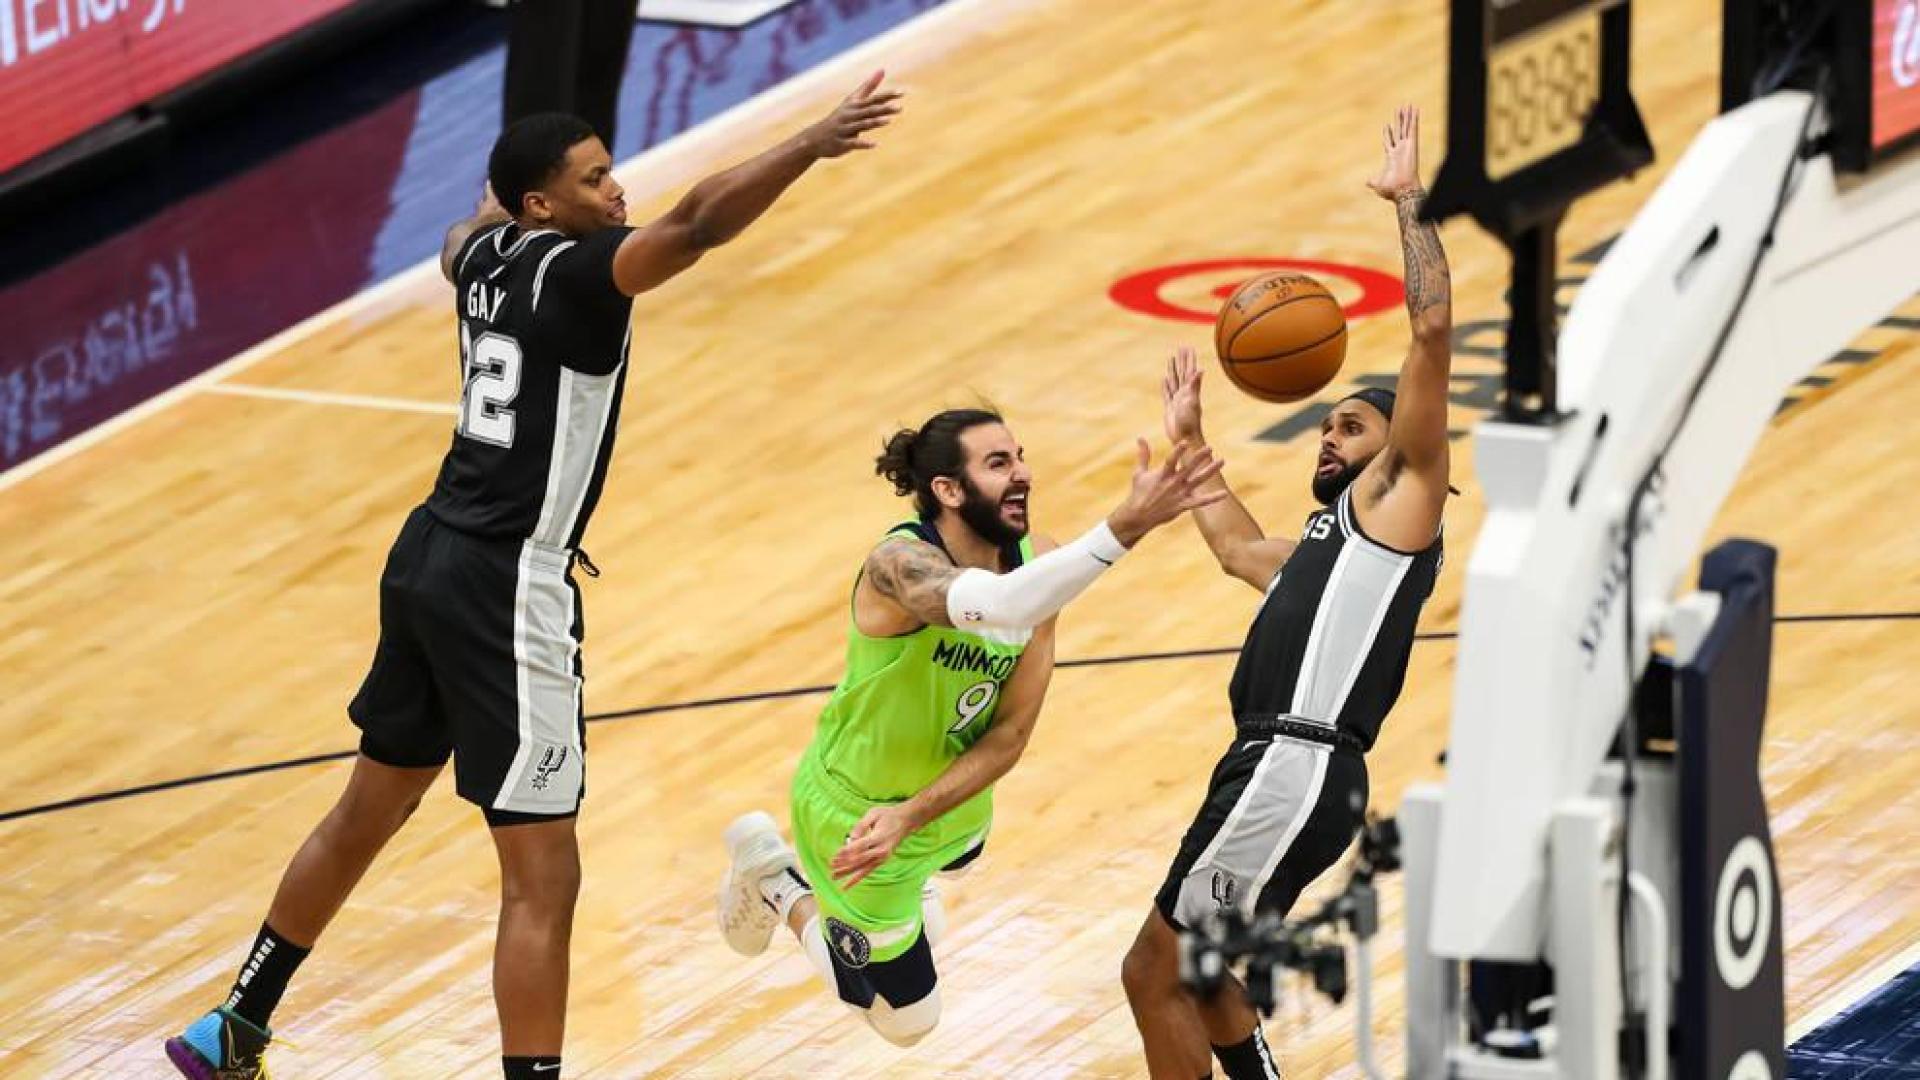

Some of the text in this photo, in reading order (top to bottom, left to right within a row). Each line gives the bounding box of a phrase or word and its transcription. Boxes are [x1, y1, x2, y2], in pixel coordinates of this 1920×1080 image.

[467, 280, 507, 323] GAY
[458, 320, 523, 449] 2
[946, 680, 999, 735] 9
